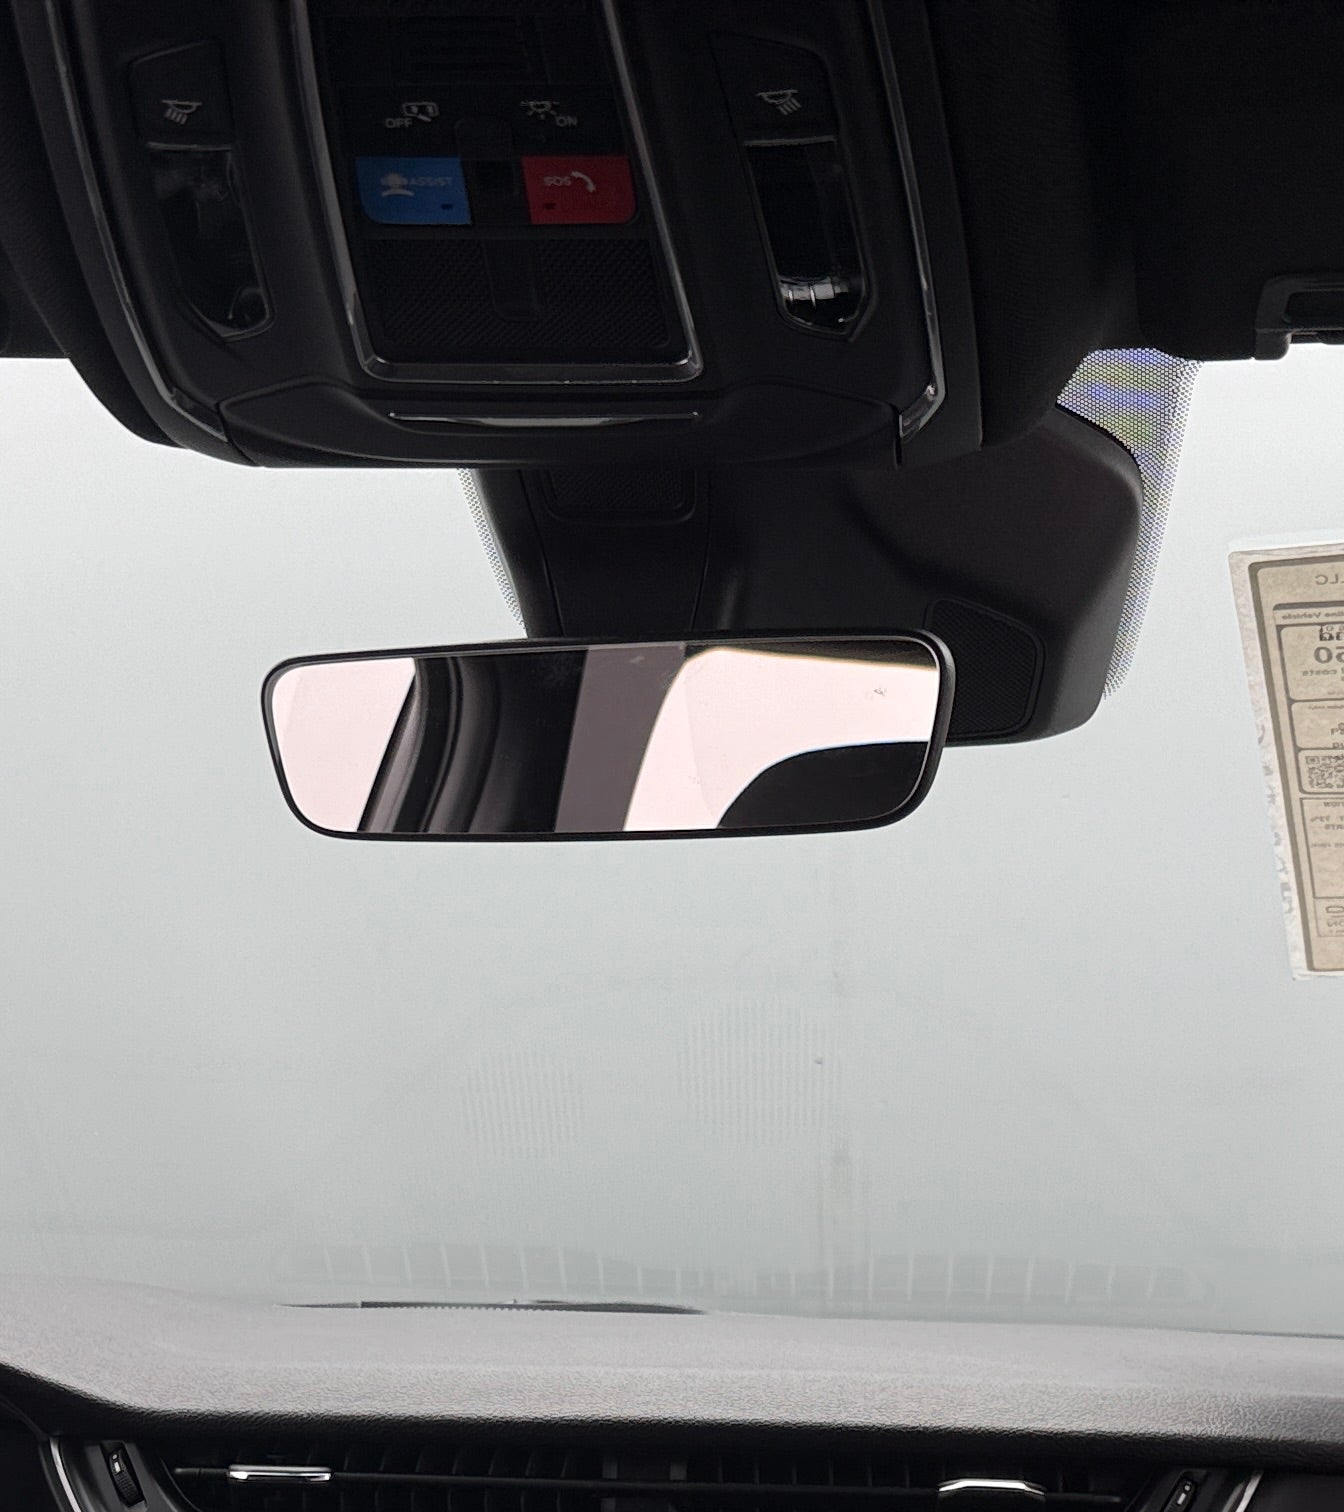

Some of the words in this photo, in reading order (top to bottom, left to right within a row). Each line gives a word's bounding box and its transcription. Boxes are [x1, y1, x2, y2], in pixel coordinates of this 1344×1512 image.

[384, 118, 413, 129] OFF
[556, 116, 578, 127] ON
[543, 176, 572, 187] SOS
